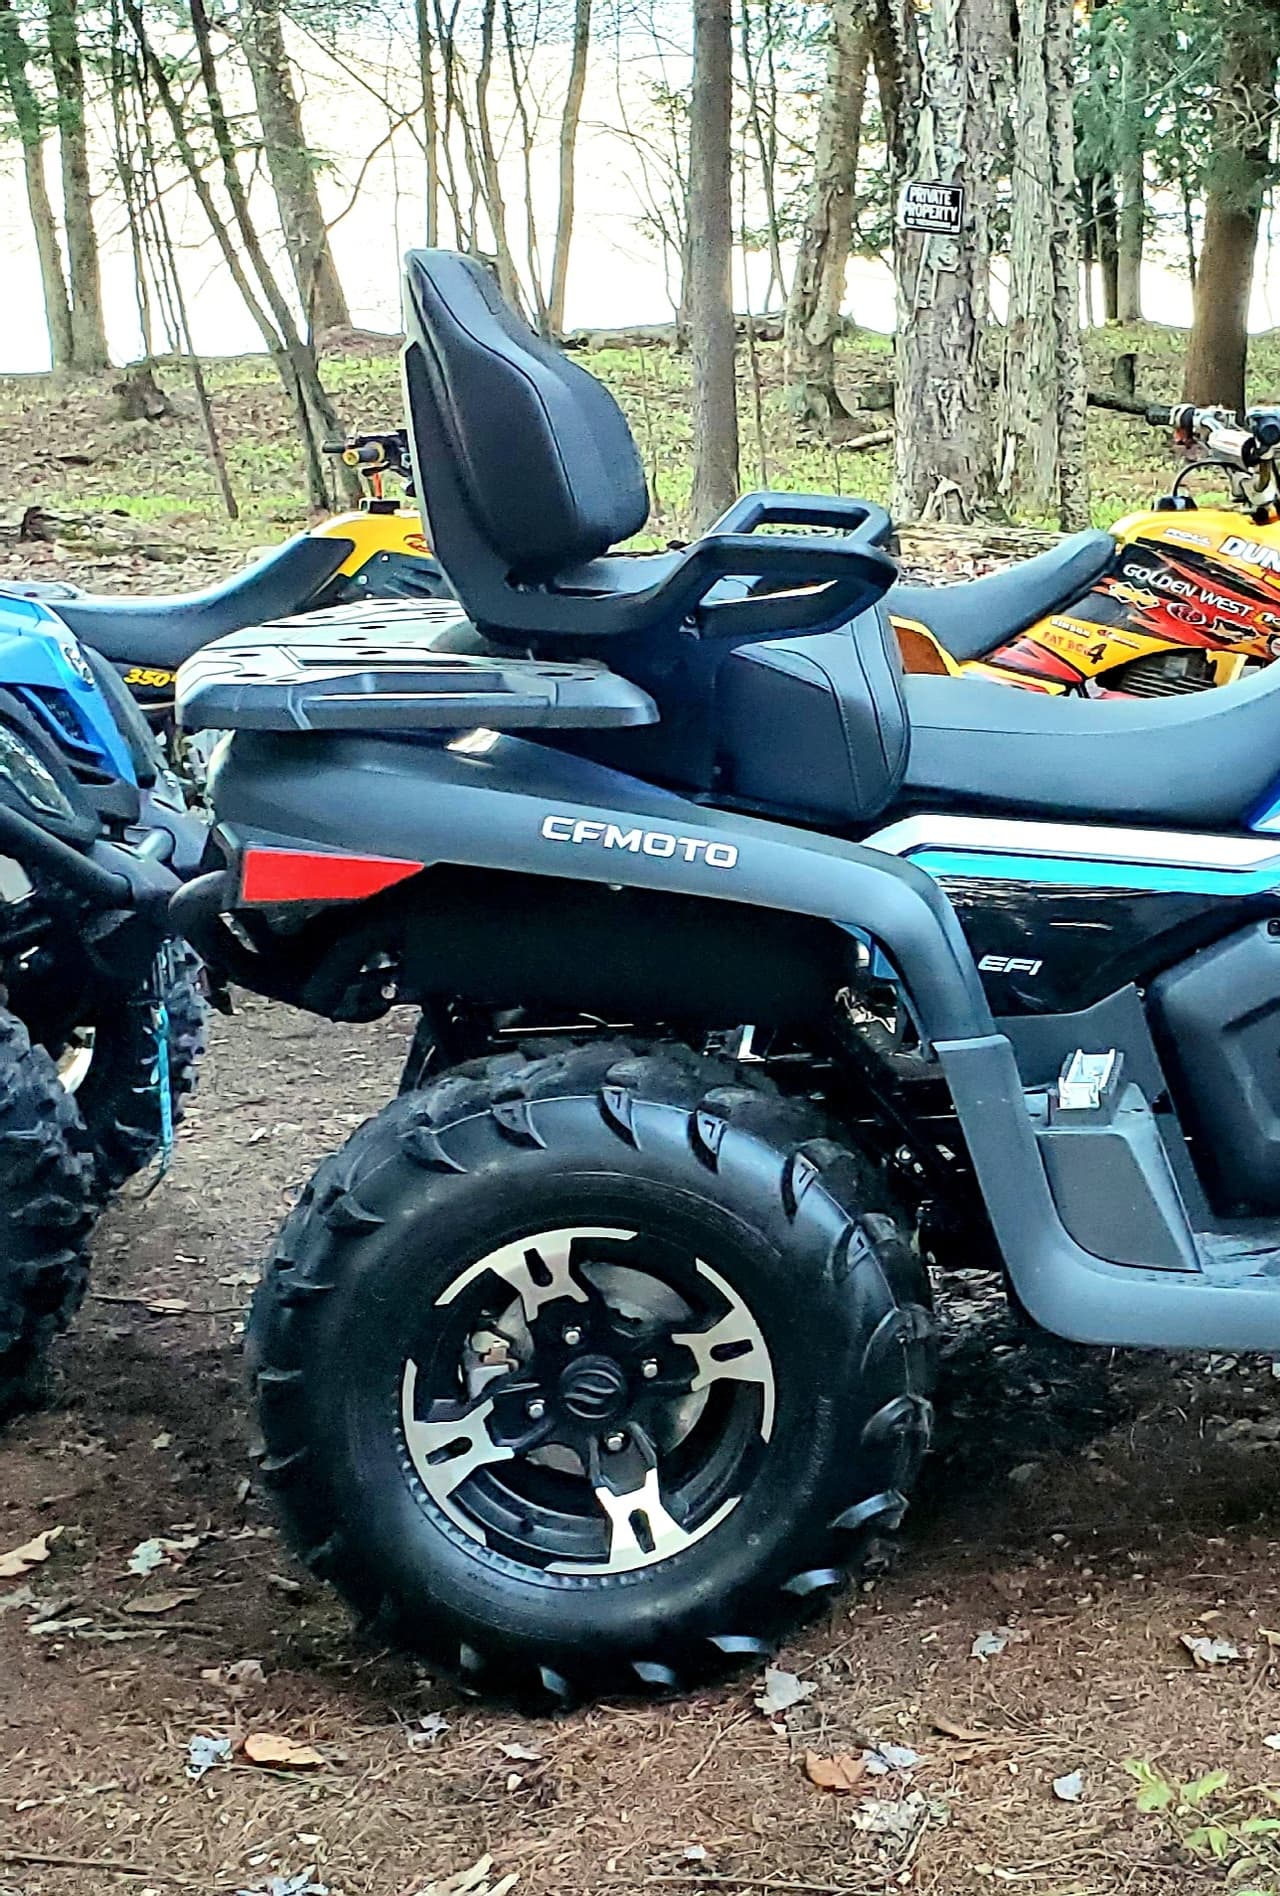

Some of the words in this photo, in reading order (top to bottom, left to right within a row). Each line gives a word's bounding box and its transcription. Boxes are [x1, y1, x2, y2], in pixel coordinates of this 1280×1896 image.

[909, 186, 953, 206] PRIVATE
[904, 202, 958, 222] PROPERTY
[1123, 564, 1198, 597] GOLDEN
[1200, 590, 1255, 617] WEST
[1088, 643, 1108, 665] 4
[123, 668, 171, 687] 350
[542, 815, 739, 868] CFMOTO
[977, 954, 1043, 976] EFI
